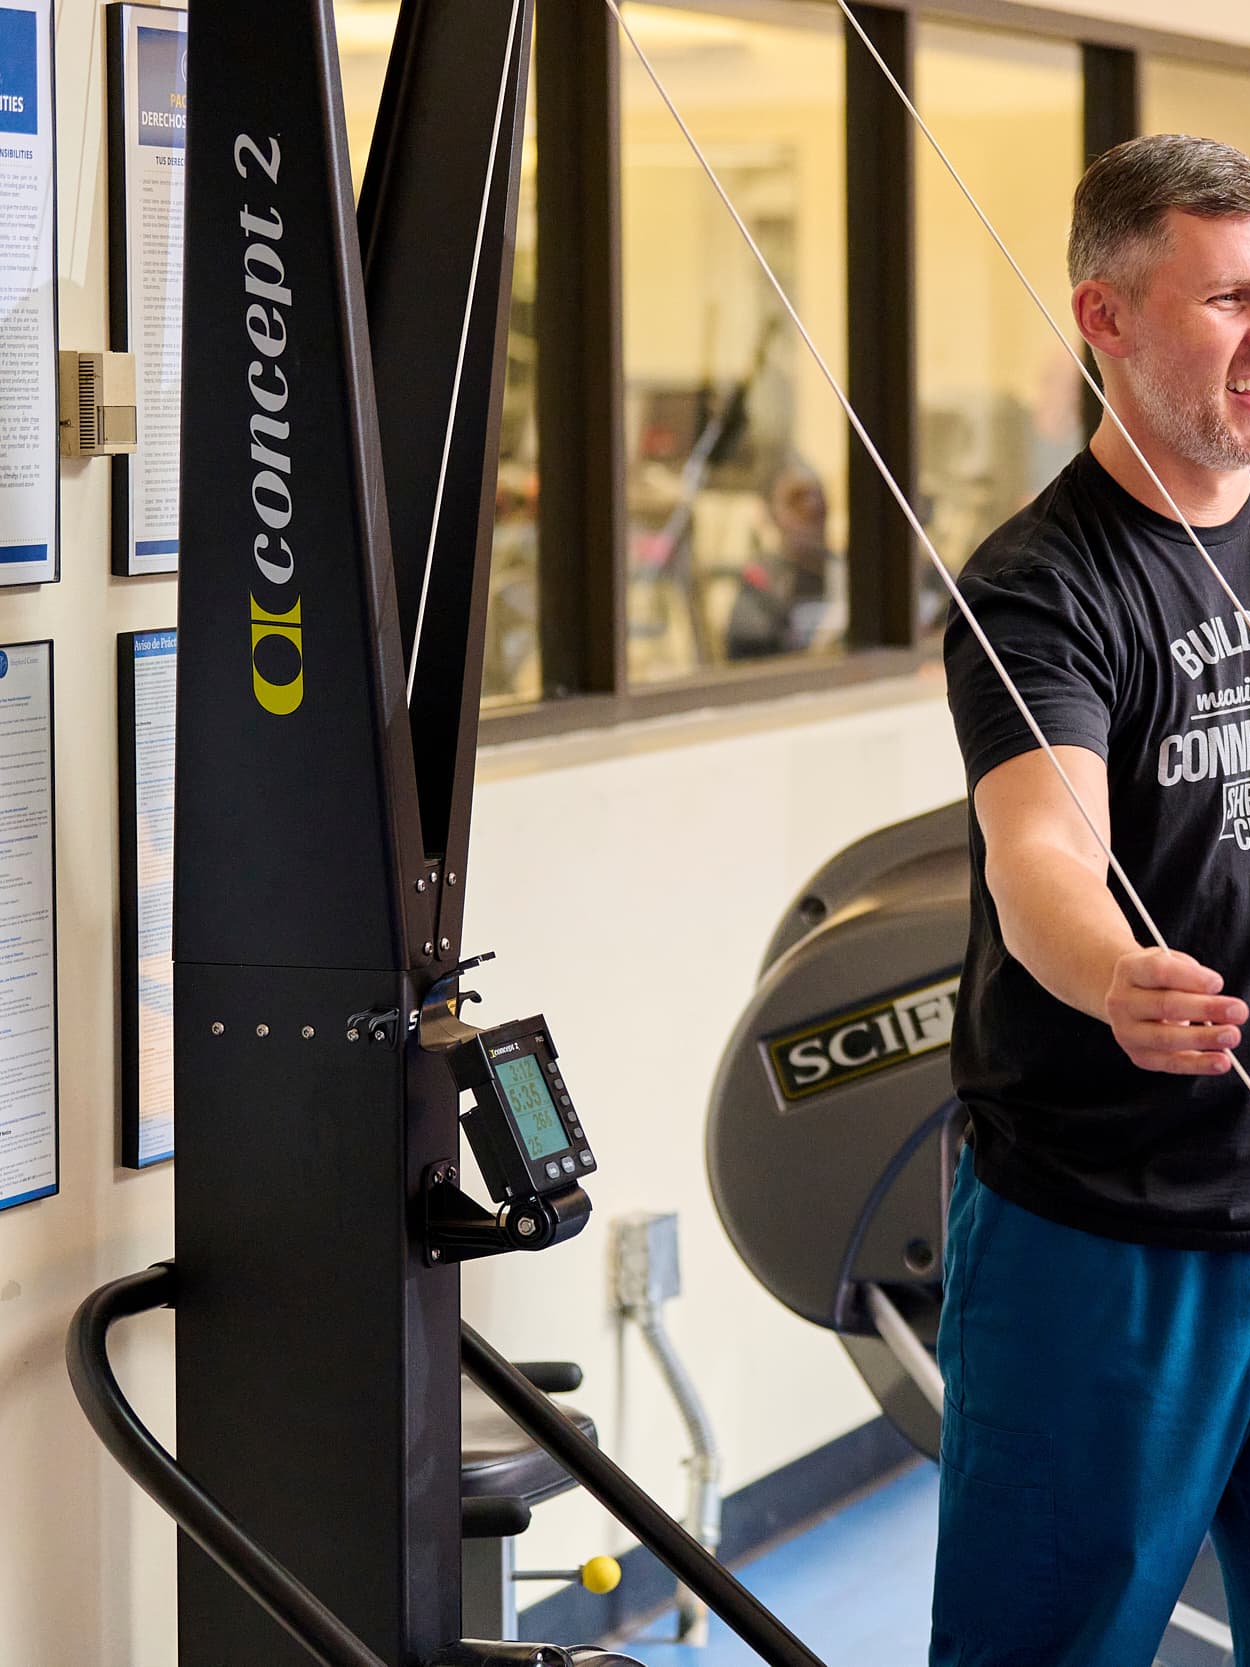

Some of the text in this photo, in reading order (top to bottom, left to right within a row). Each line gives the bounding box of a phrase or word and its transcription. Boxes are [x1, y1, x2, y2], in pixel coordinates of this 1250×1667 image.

[141, 111, 187, 129] DERECHOS
[155, 156, 166, 165] TUS
[234, 135, 296, 585] concept 2
[134, 640, 151, 651] Aviso
[152, 637, 160, 649] de
